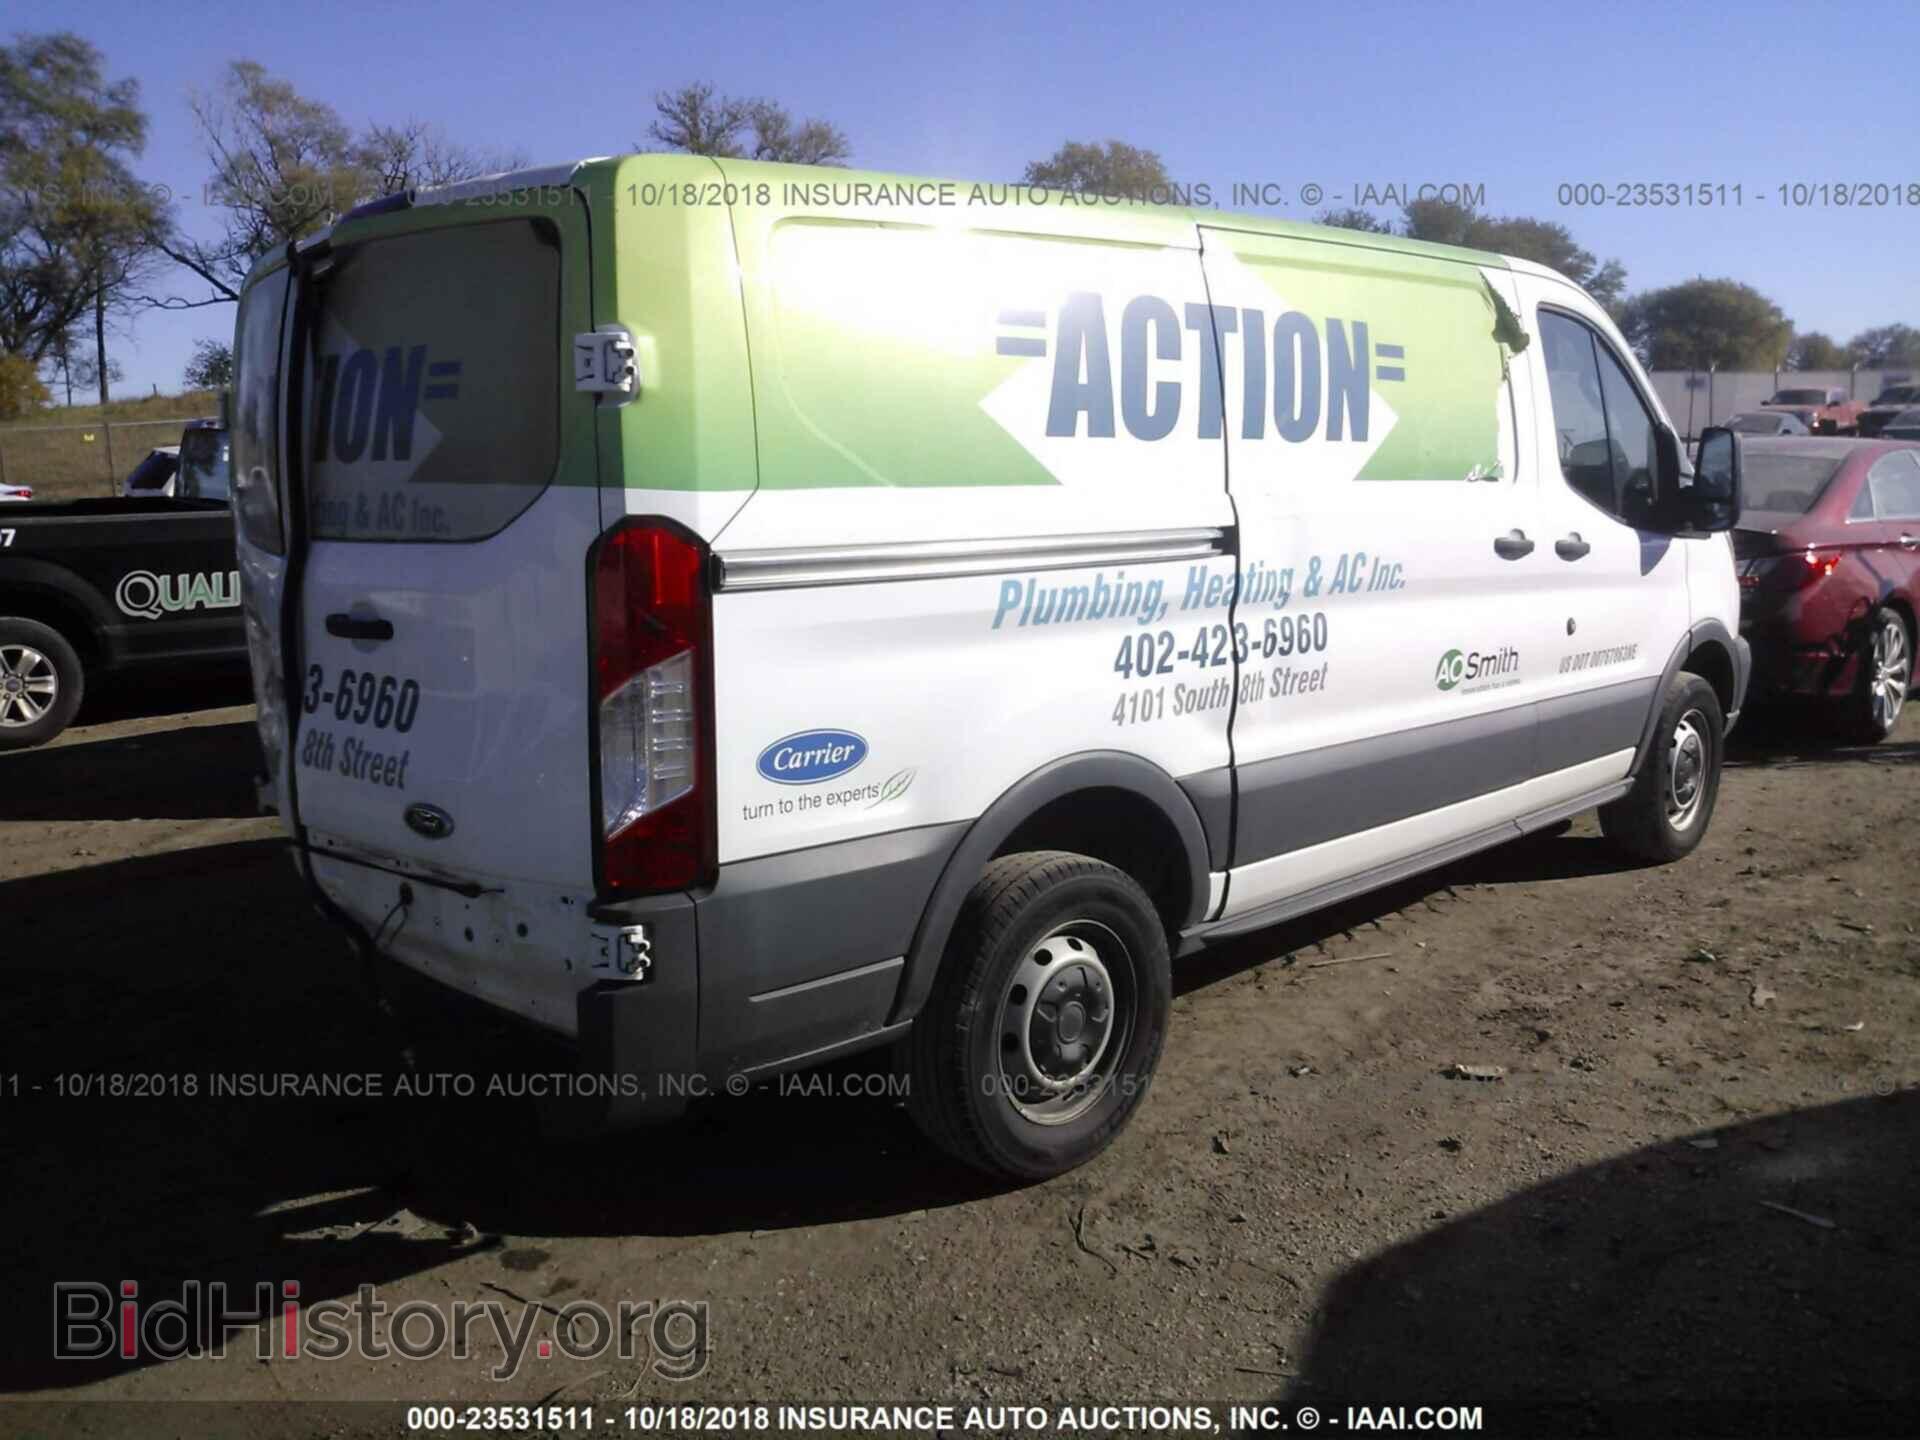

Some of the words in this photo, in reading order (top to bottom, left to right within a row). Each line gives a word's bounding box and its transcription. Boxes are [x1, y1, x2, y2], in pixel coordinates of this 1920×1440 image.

[1045, 291, 1370, 443] ACTION
[0, 529, 16, 547] 7
[991, 570, 1168, 629] Plumbing,
[1180, 560, 1295, 610] Heating
[1303, 555, 1323, 598] &
[1328, 551, 1367, 595] AC
[1367, 556, 1407, 593] Inc.
[1113, 612, 1328, 679] 402-423-6960
[1465, 646, 1520, 680] Smith
[1112, 686, 1165, 727] 4101
[1172, 676, 1231, 716] South
[1239, 669, 1265, 705] 8th
[1269, 661, 1329, 698] Street
[338, 735, 411, 790] Street
[773, 741, 856, 772] Carrier
[742, 801, 774, 821] turn
[778, 797, 794, 815] to
[798, 792, 822, 811] the
[826, 783, 880, 808] experts
